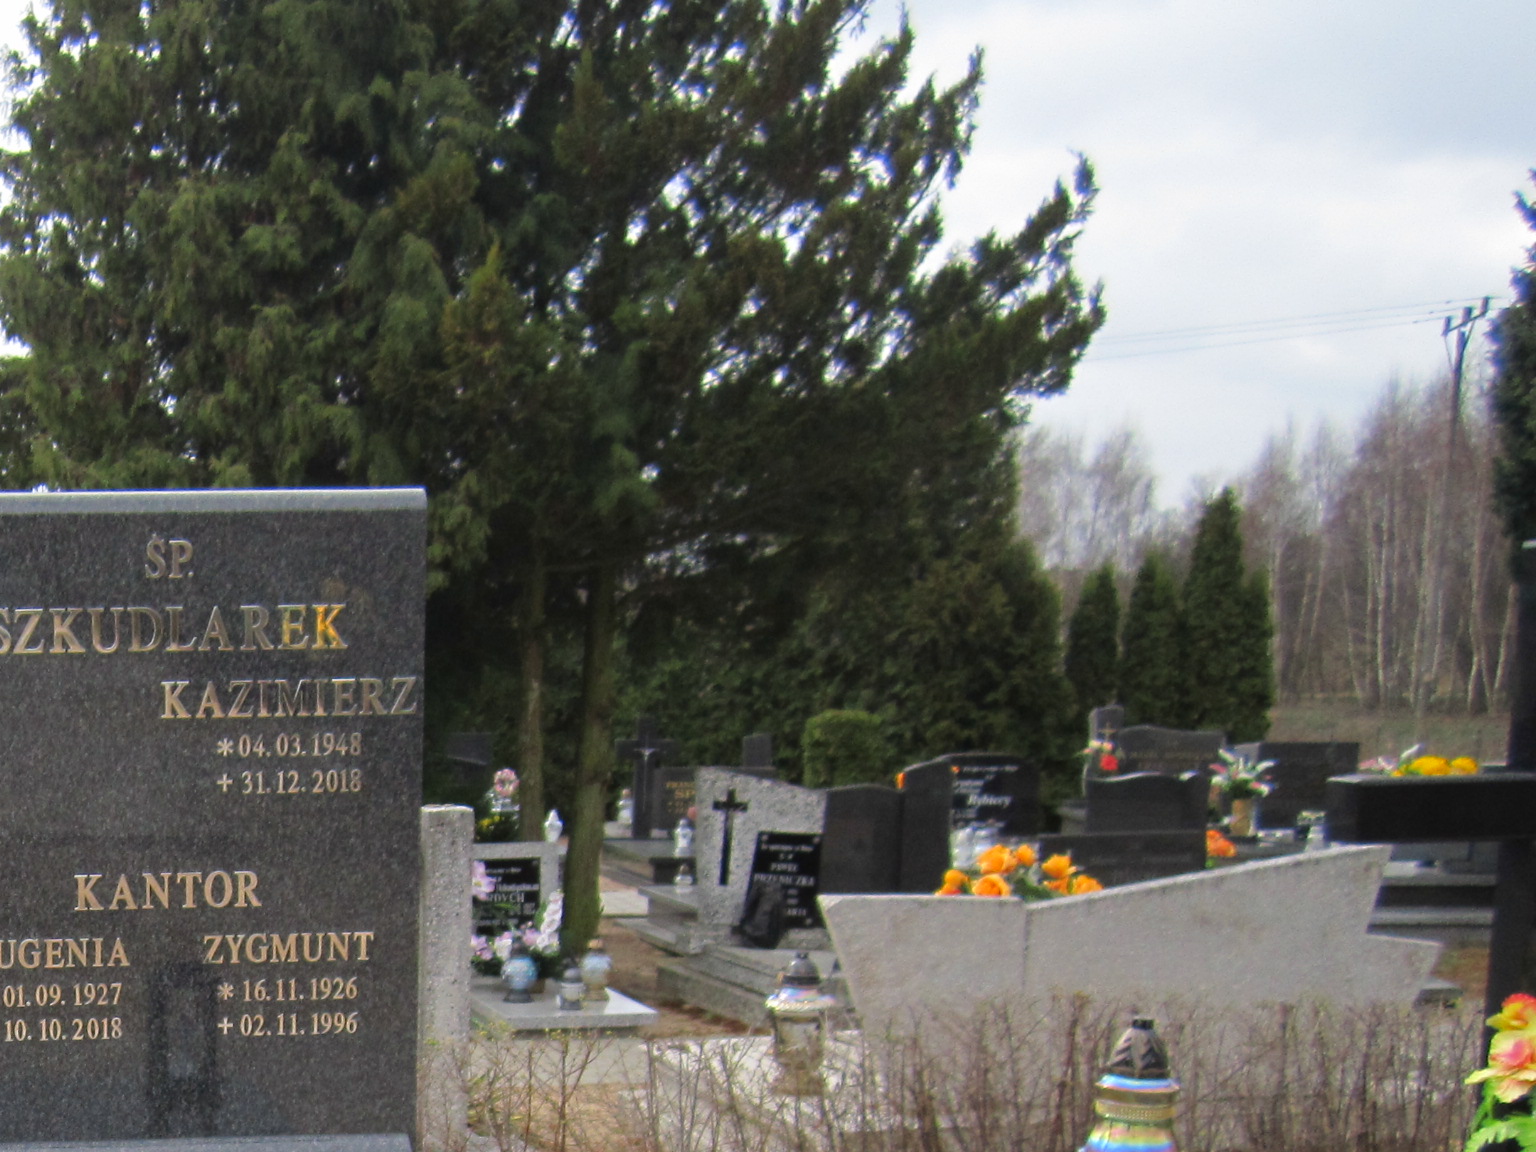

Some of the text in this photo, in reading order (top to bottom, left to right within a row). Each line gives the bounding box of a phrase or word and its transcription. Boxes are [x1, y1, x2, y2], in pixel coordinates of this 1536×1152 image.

[161, 677, 416, 719] KAZIMIERZ
[74, 871, 262, 911] KANTOR
[204, 931, 375, 964] ZYGMUNT
